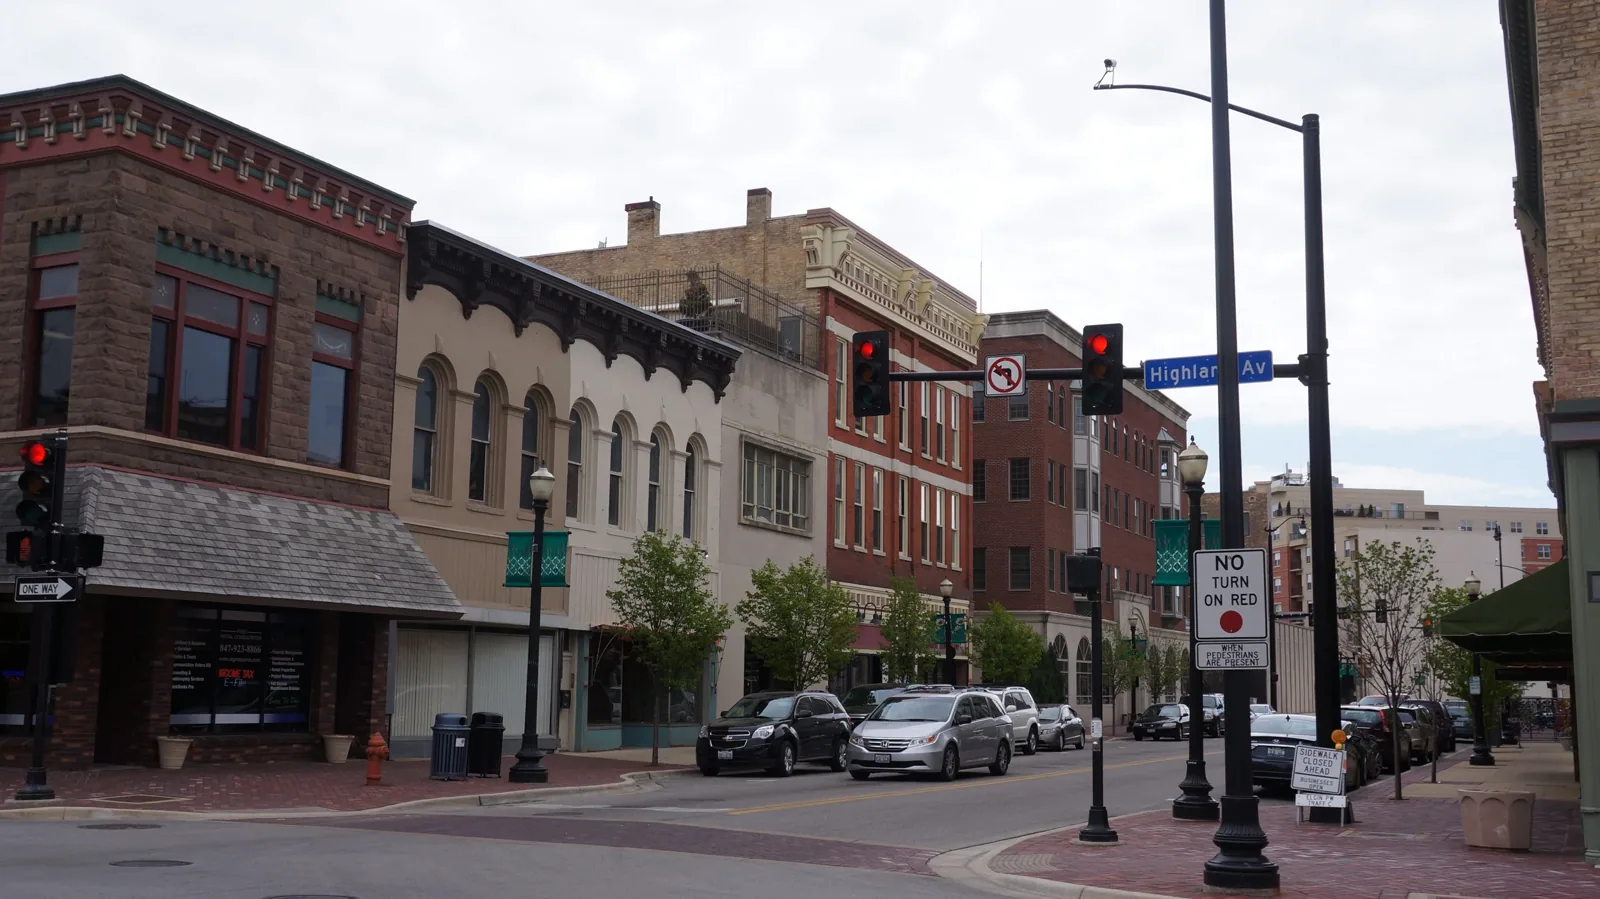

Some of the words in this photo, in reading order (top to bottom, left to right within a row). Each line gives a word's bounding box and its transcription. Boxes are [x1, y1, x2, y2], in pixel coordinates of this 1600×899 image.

[1150, 364, 1218, 385] Highlan
[1242, 359, 1266, 376] Av
[1215, 554, 1244, 571] NO
[1212, 575, 1249, 588] TURN
[22, 584, 39, 594] ONE
[41, 584, 59, 593] WAY
[1204, 594, 1223, 606] ON
[1231, 593, 1257, 606] RED
[1221, 644, 1243, 652] WHEN
[1206, 651, 1259, 659] PEDESTRIANS
[1206, 659, 1221, 667] ARE
[1225, 658, 1260, 667] PRESENT
[1299, 748, 1339, 760] SIDEWALK
[1302, 757, 1333, 768] CLOSED
[1303, 765, 1330, 775] AHEAD
[1300, 777, 1334, 786] BUSINESSES
